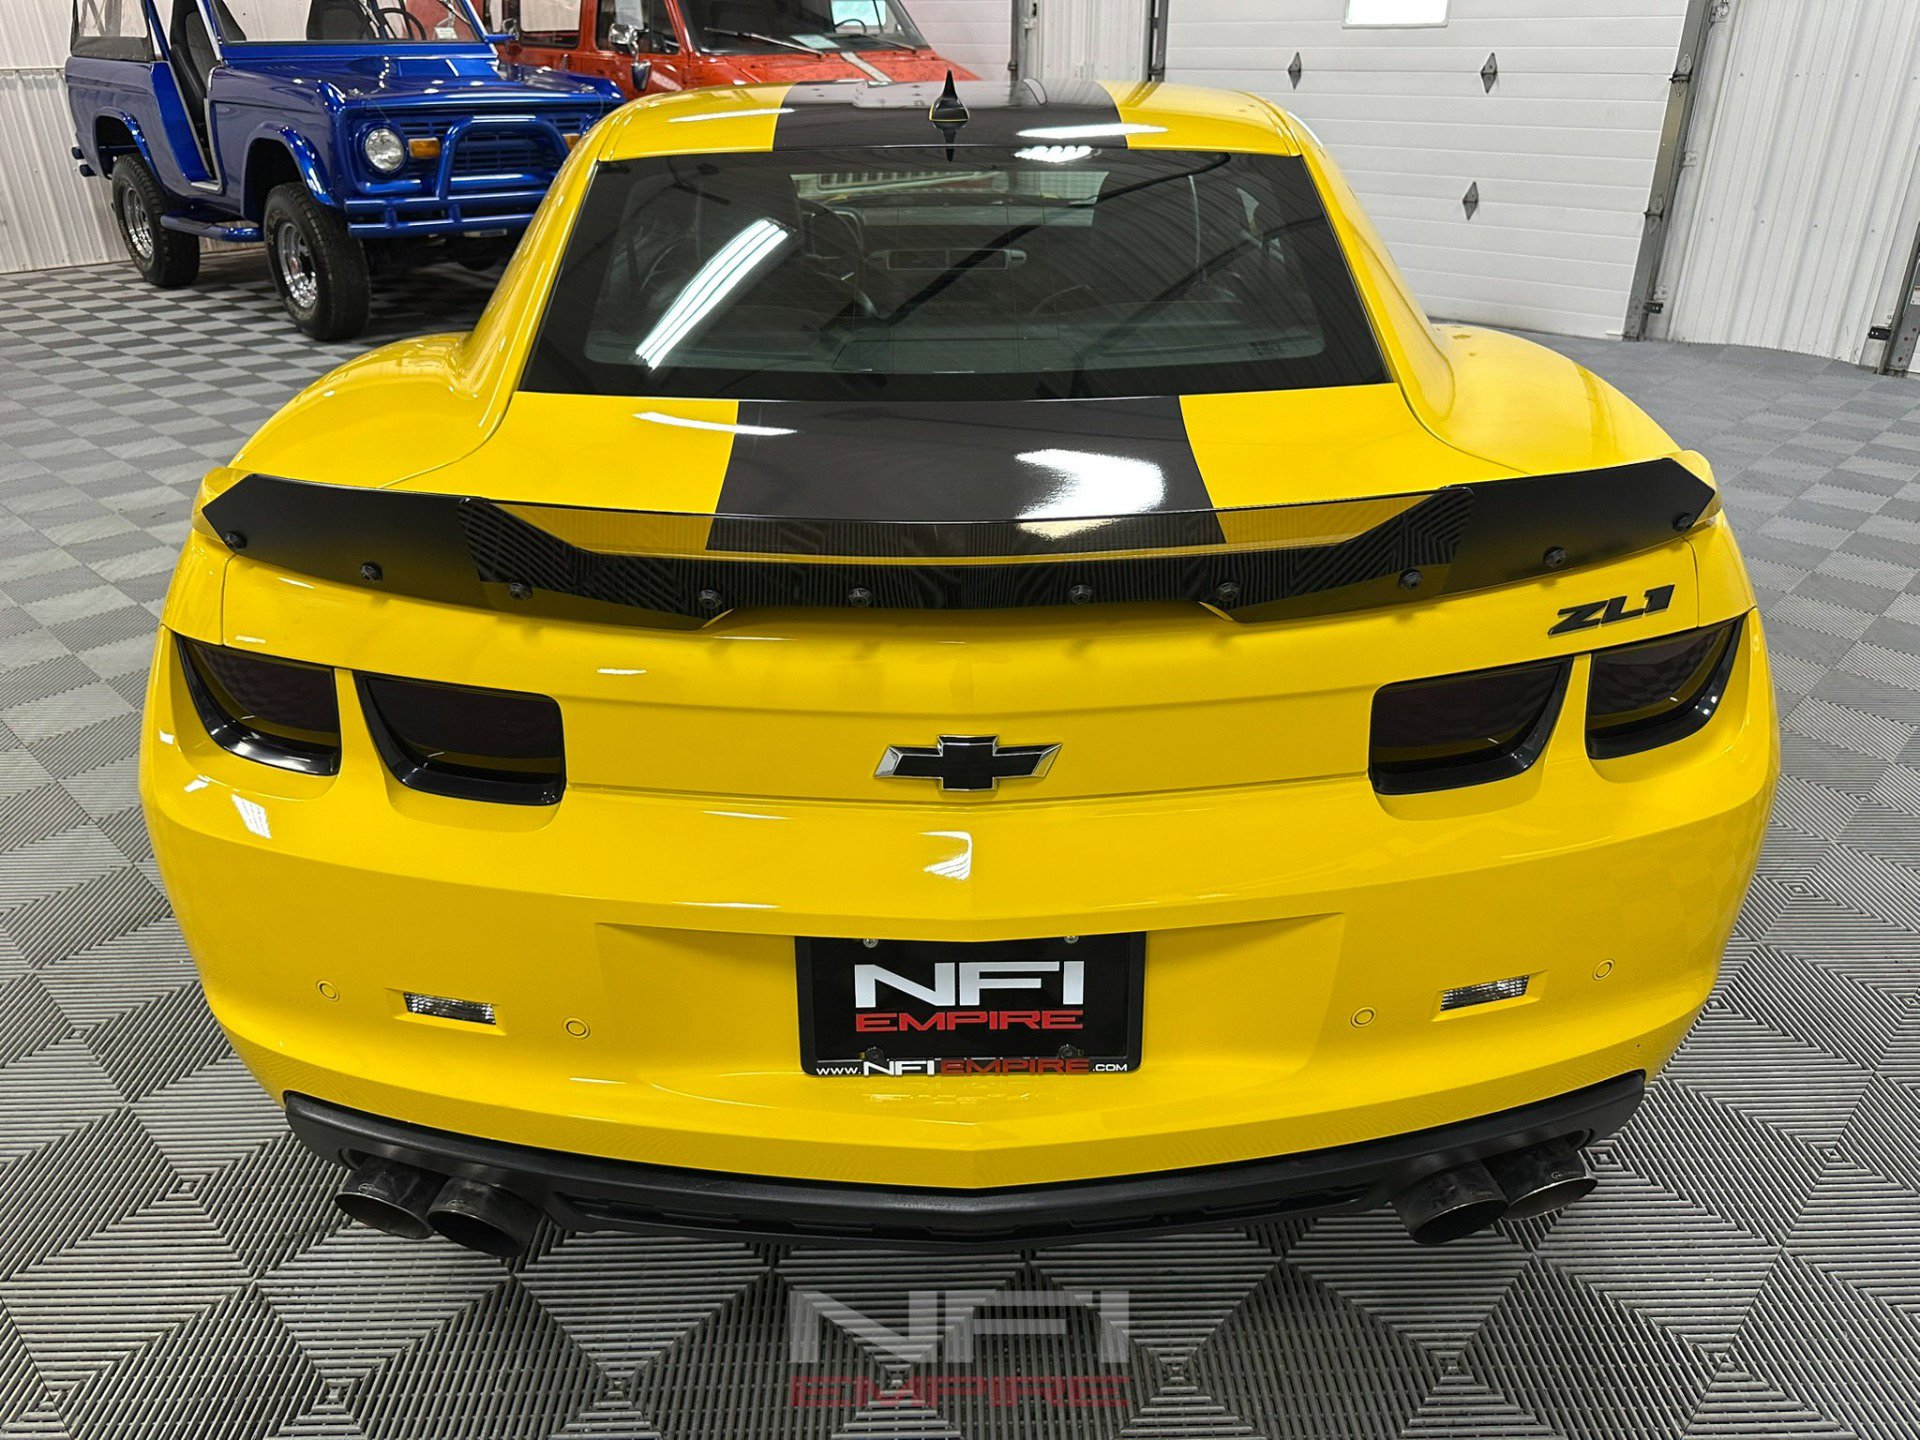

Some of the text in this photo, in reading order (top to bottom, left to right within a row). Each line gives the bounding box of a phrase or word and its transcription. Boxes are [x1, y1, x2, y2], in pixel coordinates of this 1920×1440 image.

[1548, 584, 1675, 637] ZL1
[854, 961, 1084, 1008] NFI
[855, 1010, 1084, 1032] EMPIRE
